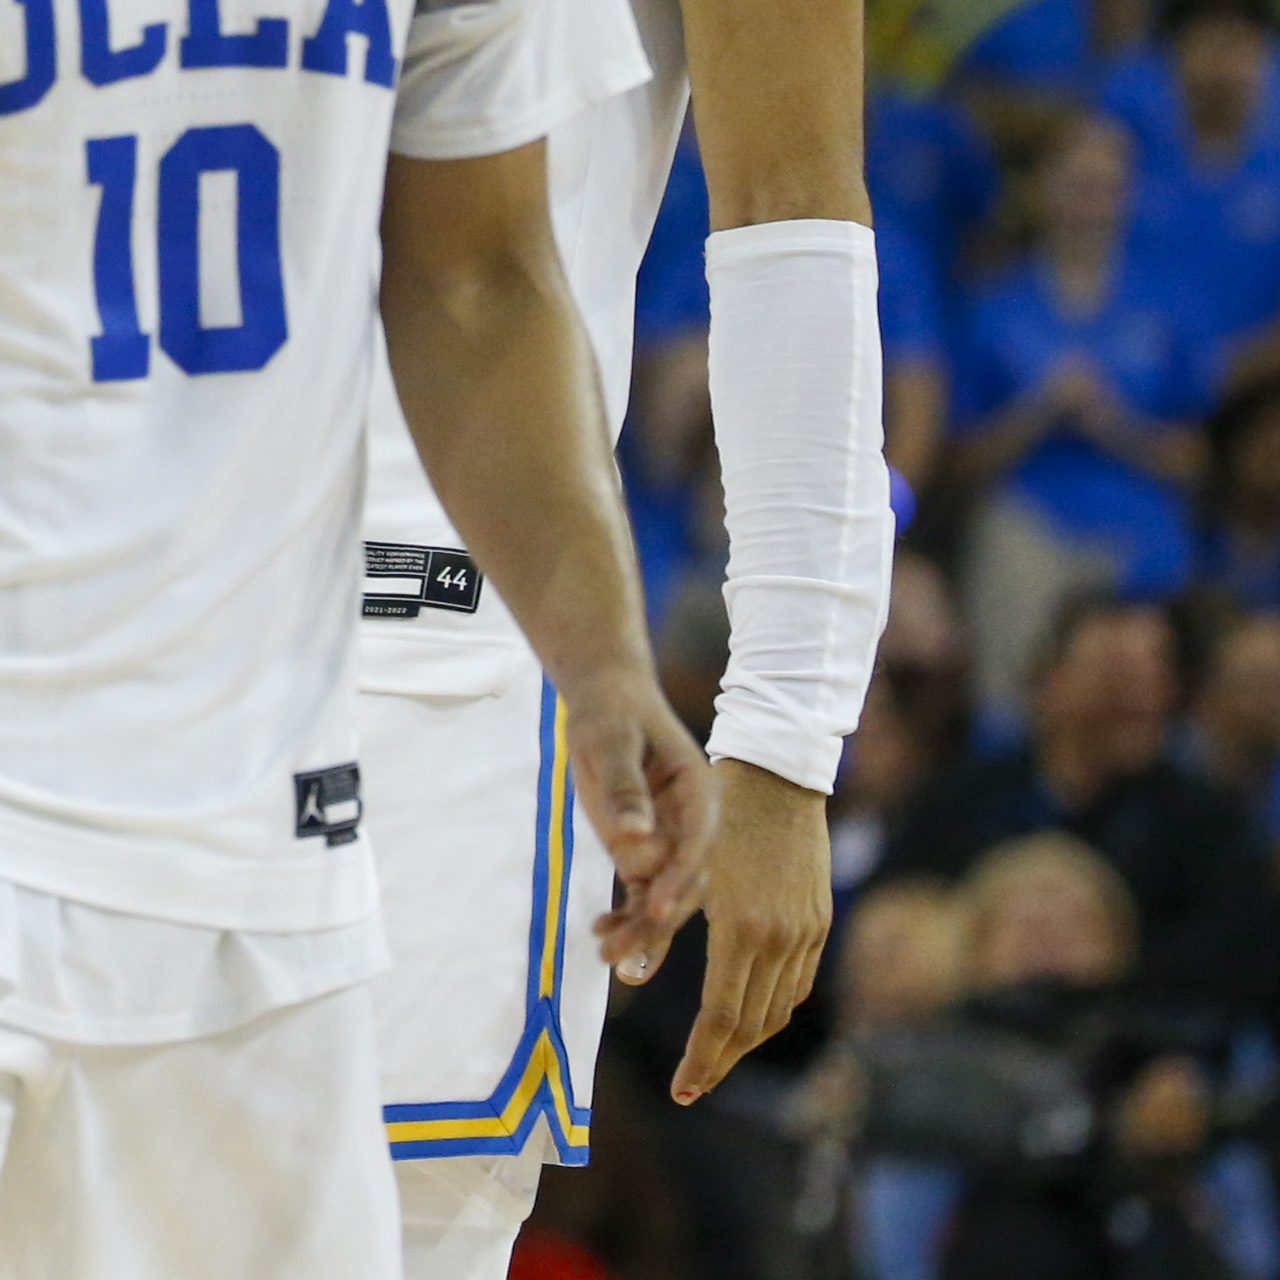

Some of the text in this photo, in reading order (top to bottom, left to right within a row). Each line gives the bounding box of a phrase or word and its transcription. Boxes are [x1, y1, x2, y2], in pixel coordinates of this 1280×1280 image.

[85, 123, 290, 383] 10
[436, 566, 468, 591] 44
[364, 606, 407, 614] 2021-2022
